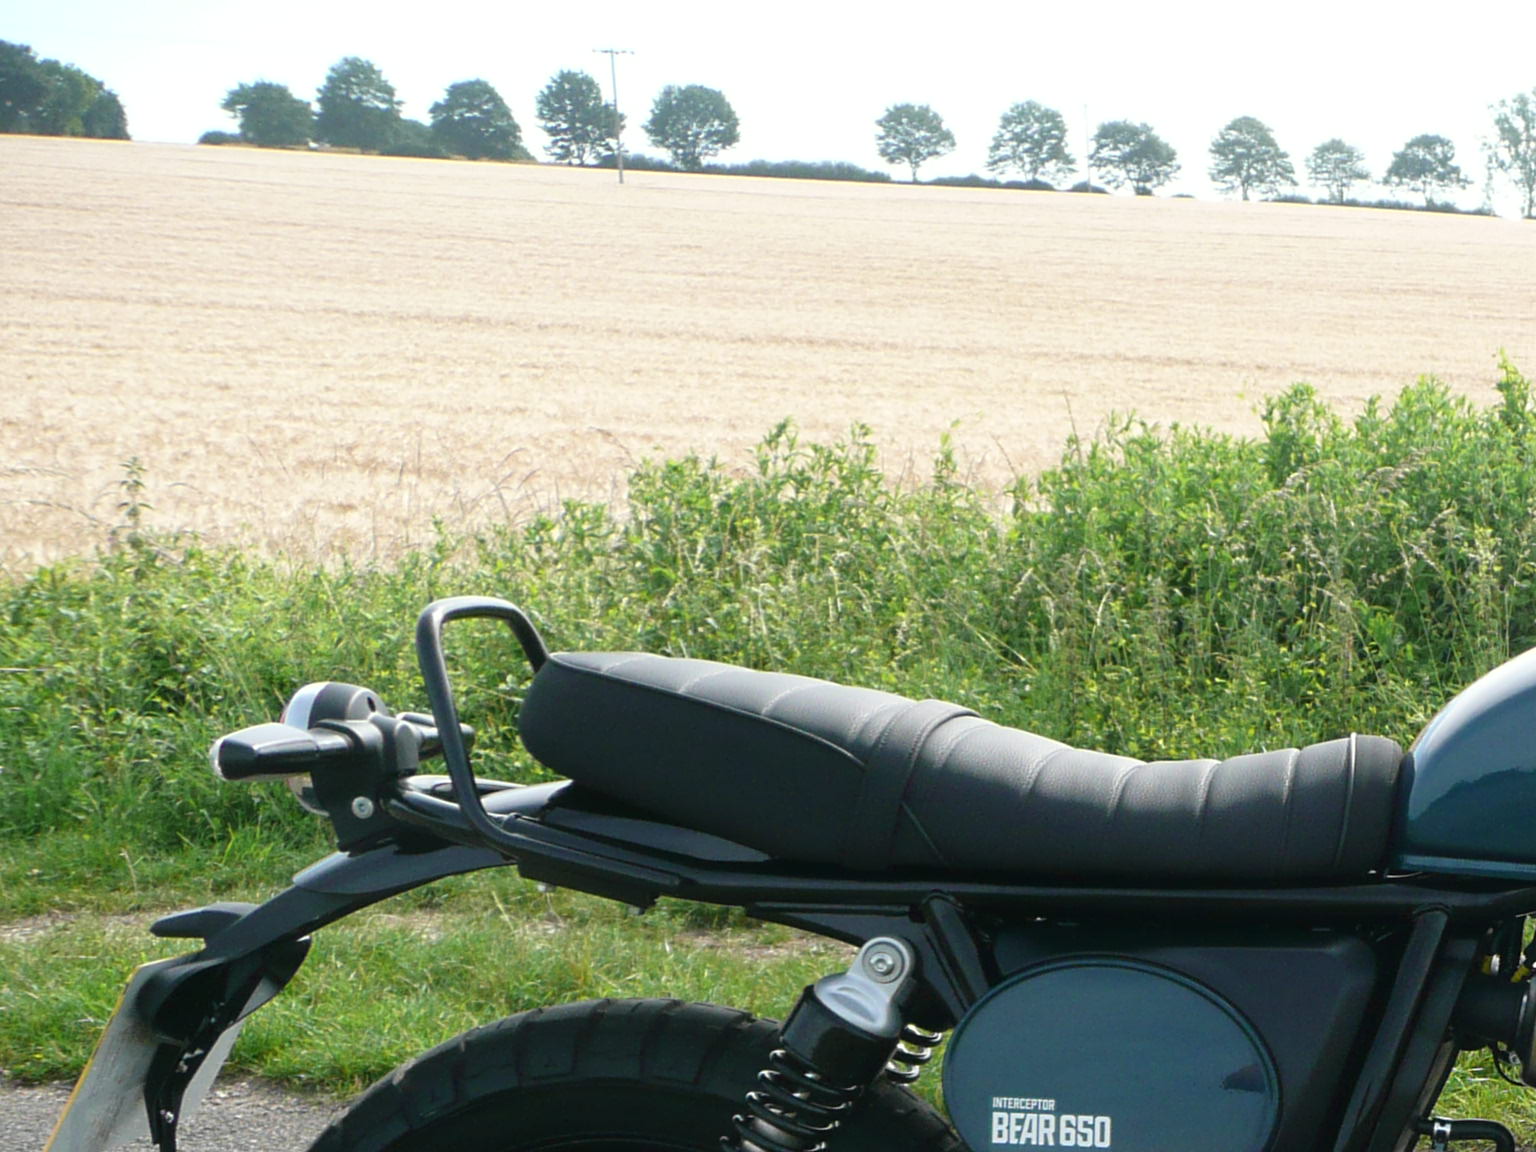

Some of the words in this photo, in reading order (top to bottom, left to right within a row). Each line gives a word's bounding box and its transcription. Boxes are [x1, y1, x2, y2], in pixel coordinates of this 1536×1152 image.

[992, 1097, 1056, 1110] INTERCEPTOR
[991, 1112, 1056, 1146] BEAR
[1059, 1114, 1112, 1148] 650
